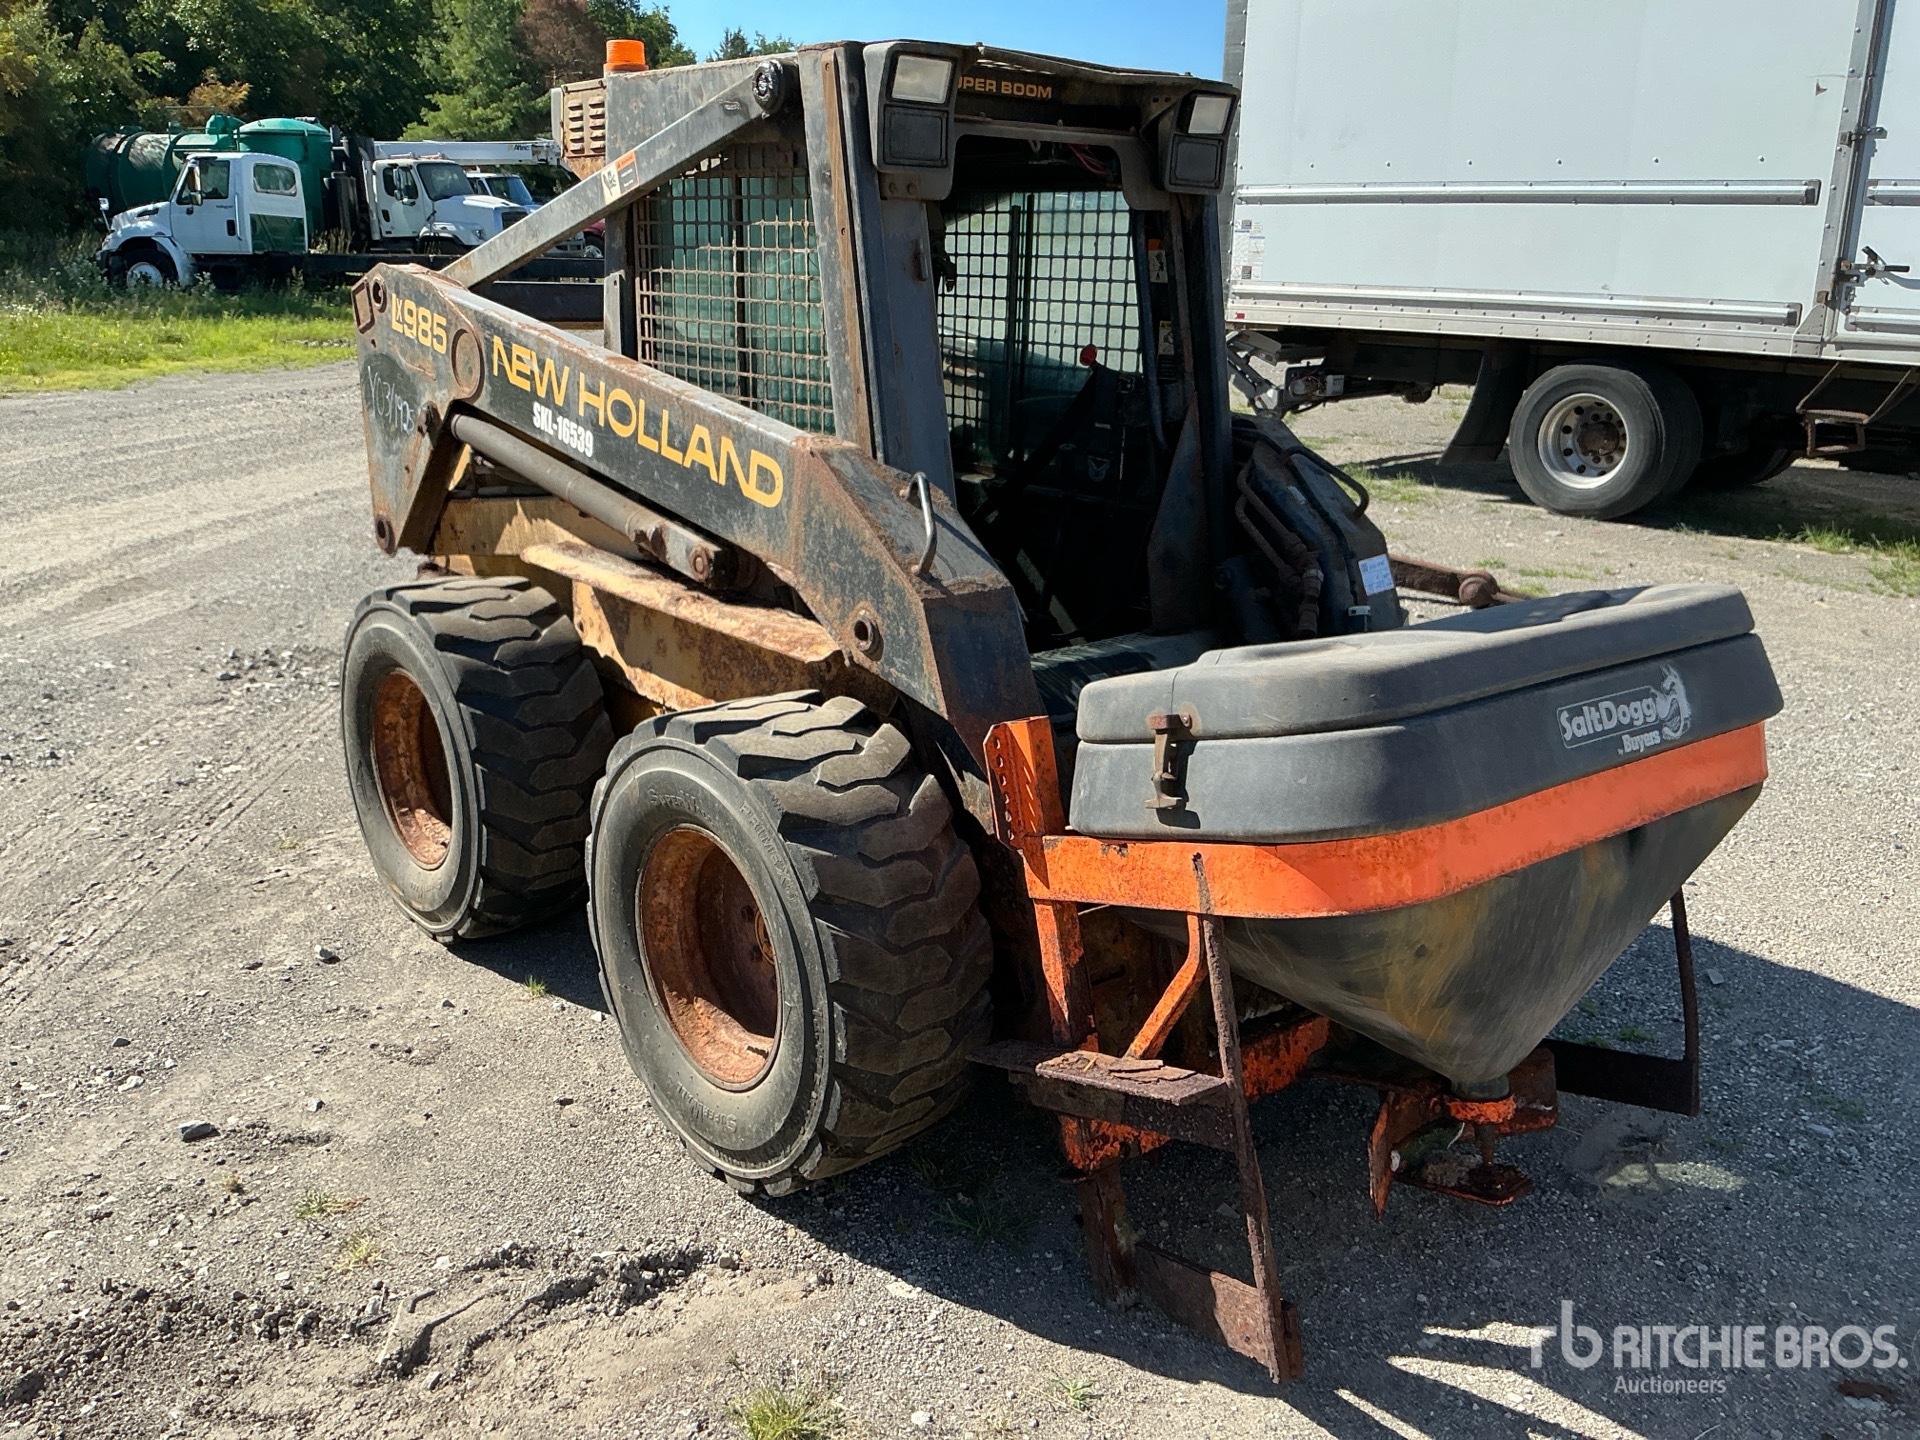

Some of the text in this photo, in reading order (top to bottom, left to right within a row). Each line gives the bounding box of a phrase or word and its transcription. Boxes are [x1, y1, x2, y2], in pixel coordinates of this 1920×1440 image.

[1001, 81, 1052, 99] BOOM
[492, 335, 784, 508] NEW HOLLAND
[532, 400, 594, 459] SKL-16539
[1560, 697, 1657, 741] SaltDogg
[1621, 730, 1661, 753] Buyers
